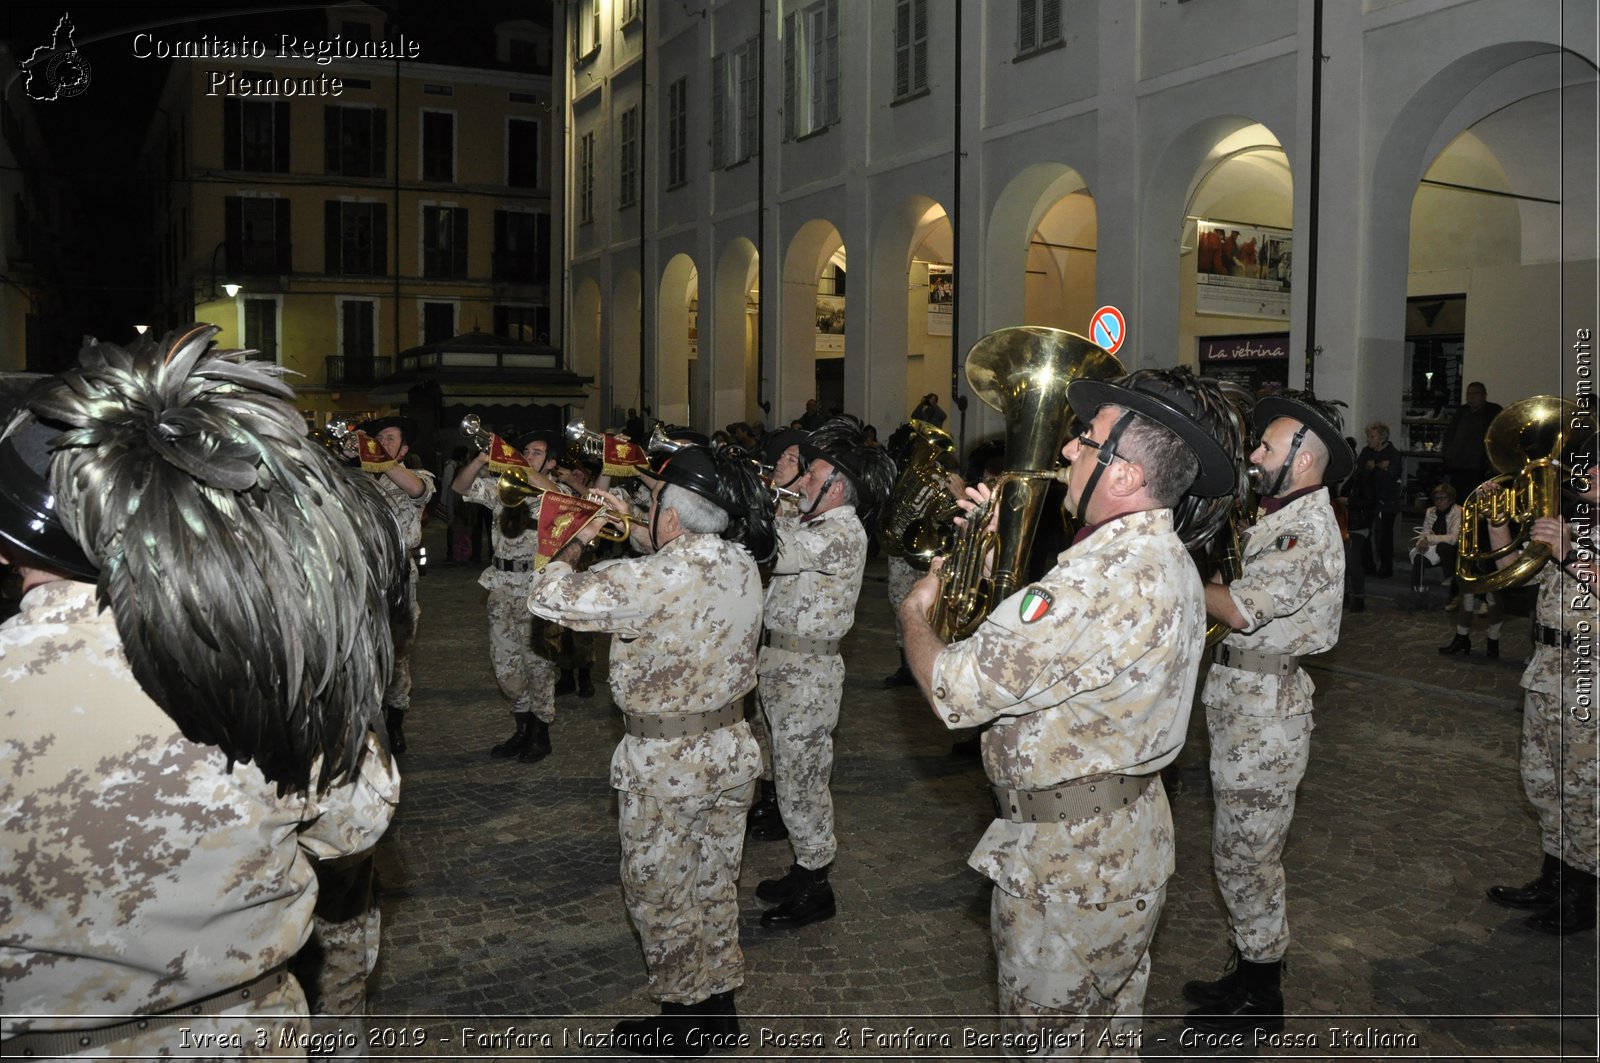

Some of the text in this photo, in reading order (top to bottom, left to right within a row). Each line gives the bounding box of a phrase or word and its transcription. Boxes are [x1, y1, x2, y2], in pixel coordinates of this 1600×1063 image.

[1208, 341, 1285, 359] La vetrina
[1031, 589, 1052, 604] ITALIA
